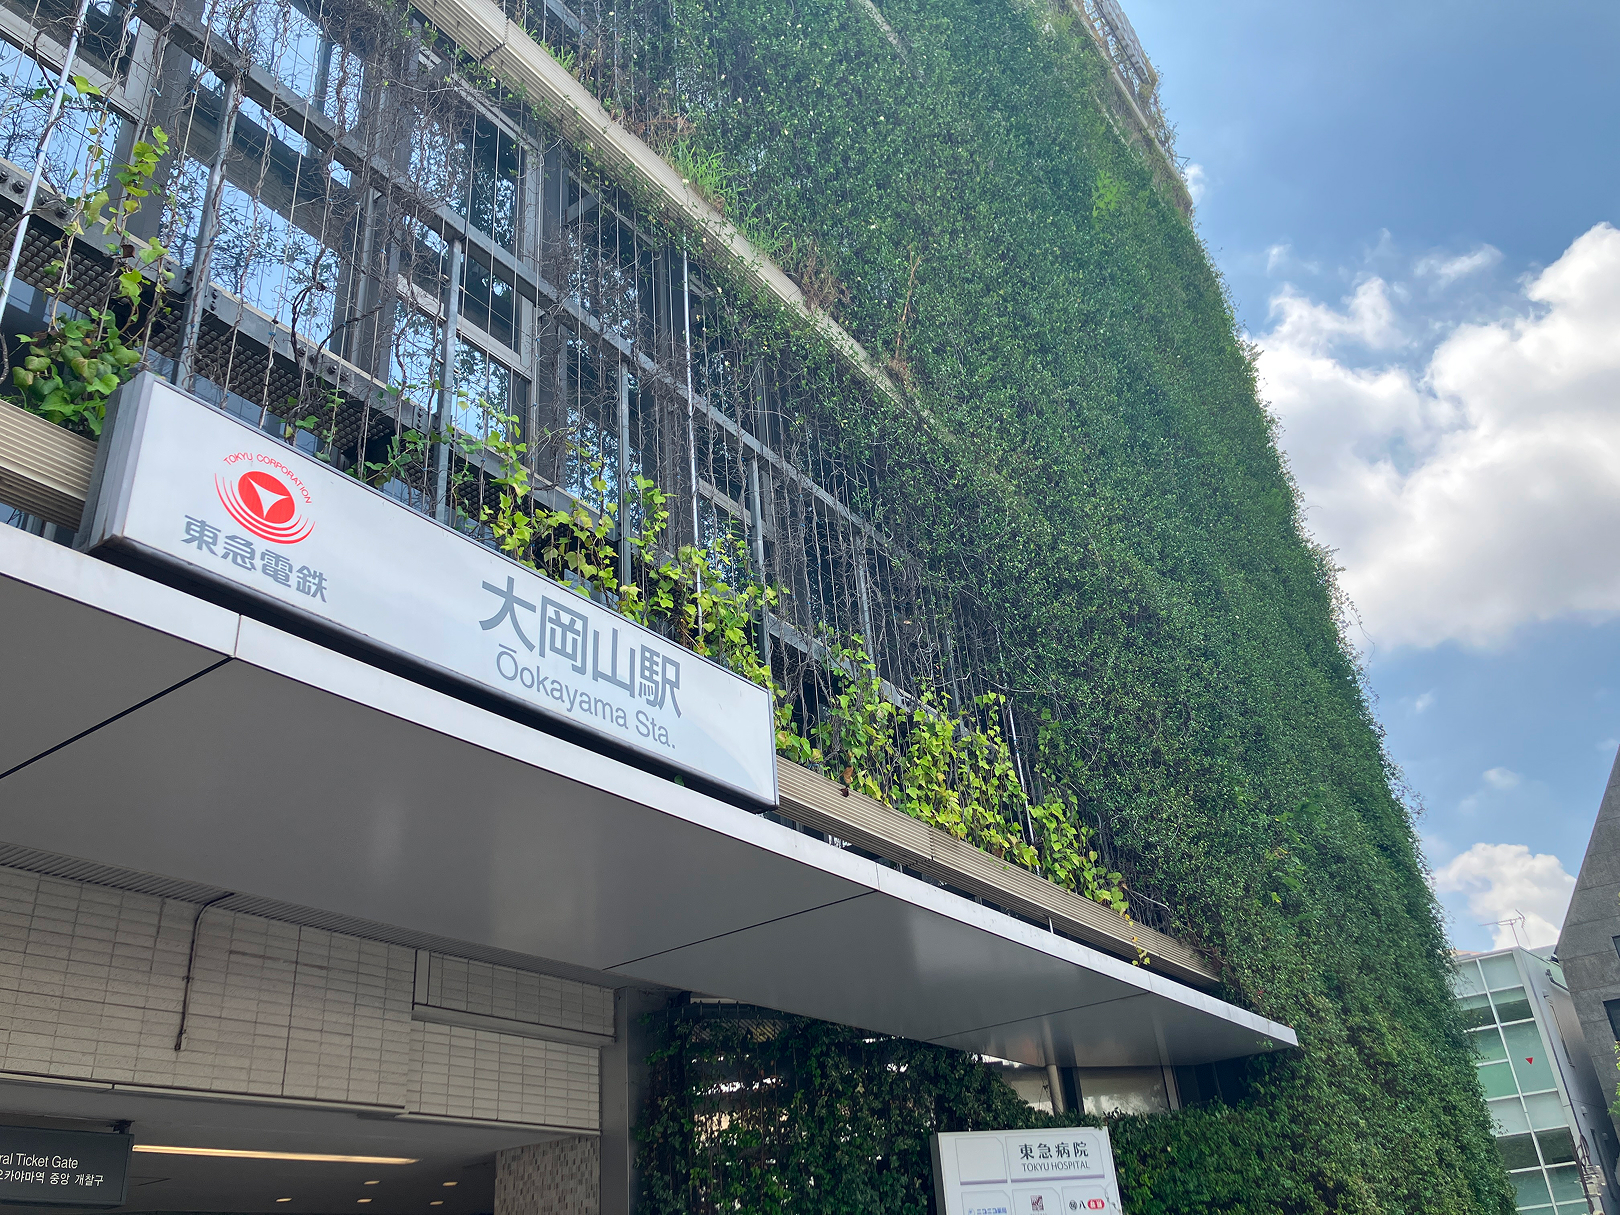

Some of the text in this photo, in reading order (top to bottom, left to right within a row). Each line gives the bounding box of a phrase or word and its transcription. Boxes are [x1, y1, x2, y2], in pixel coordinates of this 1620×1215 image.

[223, 452, 312, 504] TOKYU CORPORATION
[181, 514, 328, 603] 東急電鉄
[478, 575, 682, 719] 大岡山駅
[496, 643, 676, 750] Ōokayama Sta.
[16, 1153, 49, 1167] Ticket
[51, 1155, 79, 1169] Gate
[1018, 1140, 1089, 1160] 東急病院
[1021, 1160, 1091, 1172] TOKYU HOSPITAL
[49, 1172, 71, 1185] 중앙
[74, 1173, 104, 1187] 개찰구
